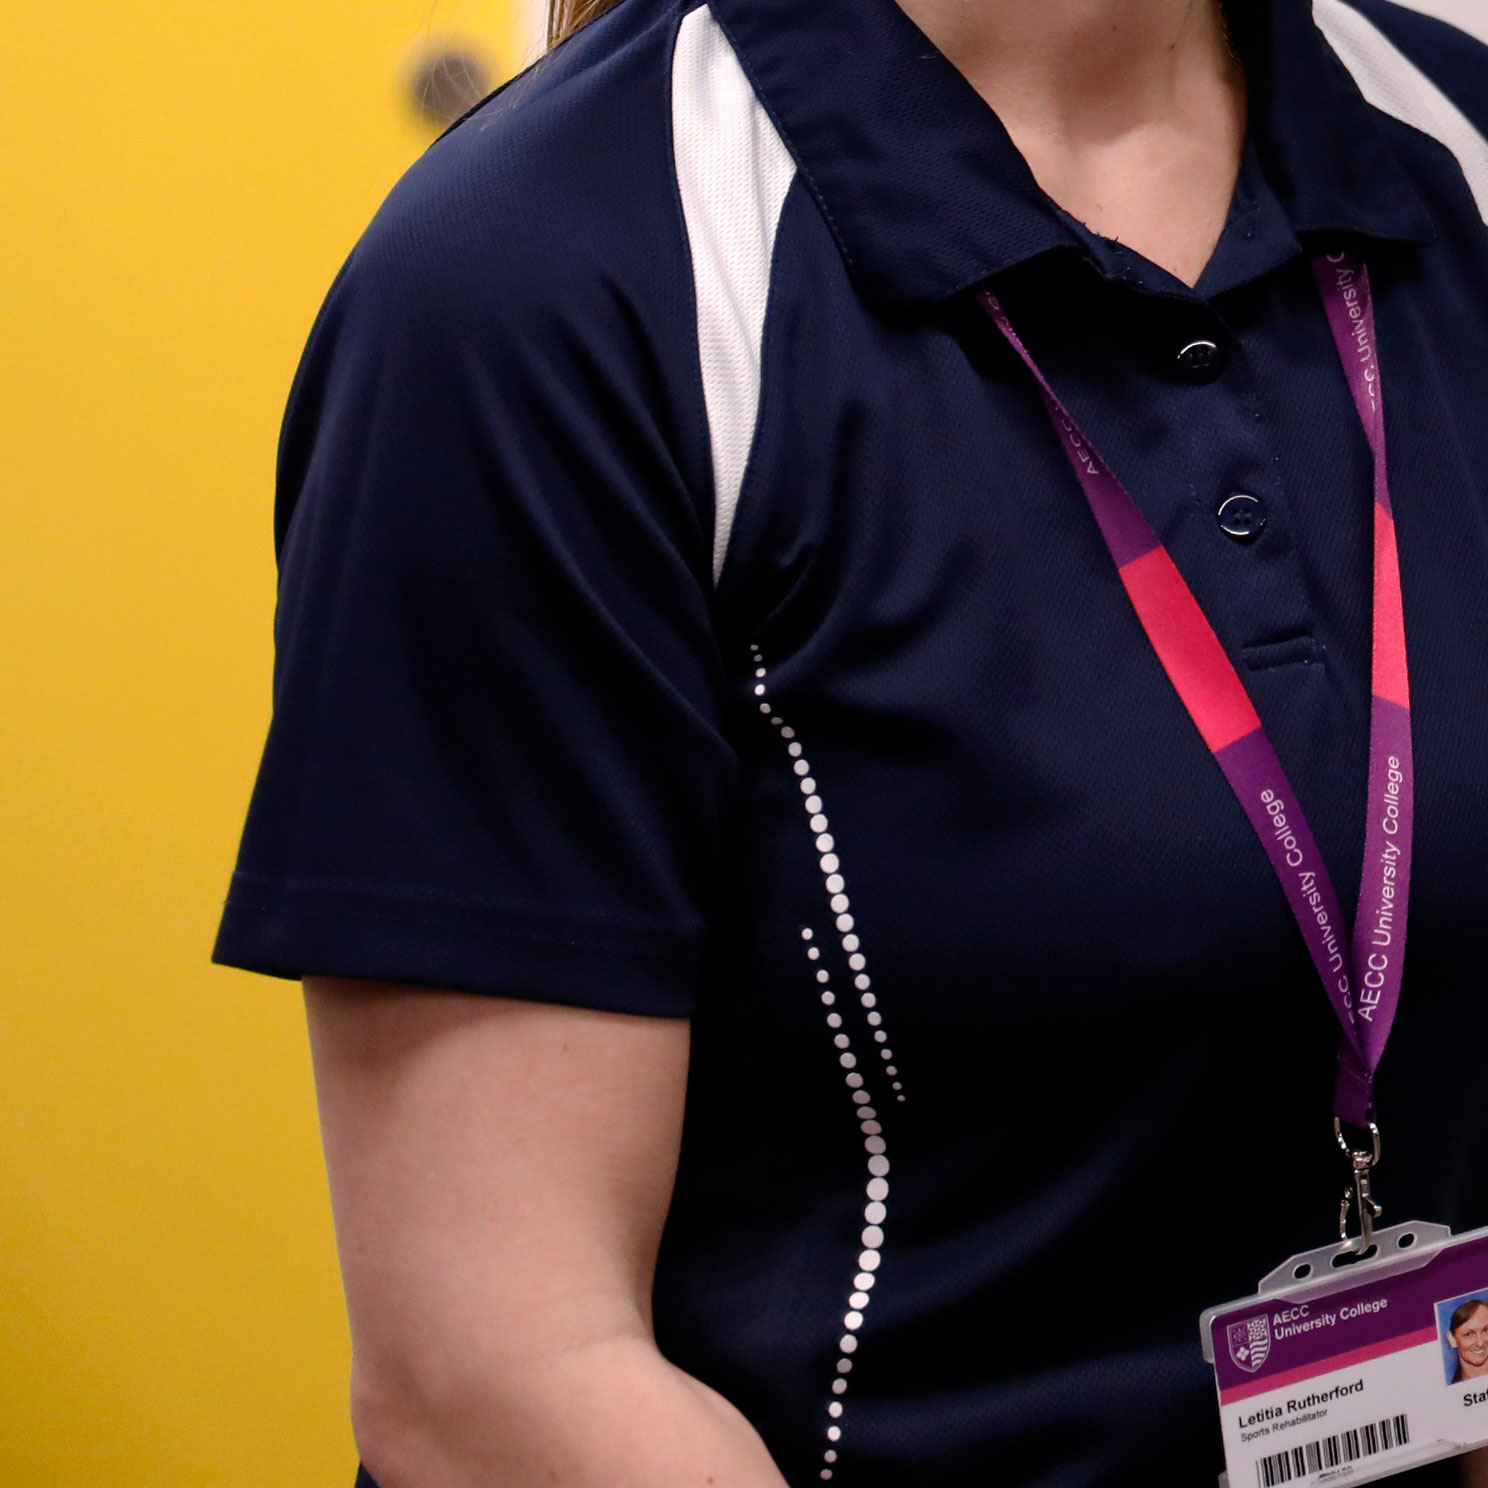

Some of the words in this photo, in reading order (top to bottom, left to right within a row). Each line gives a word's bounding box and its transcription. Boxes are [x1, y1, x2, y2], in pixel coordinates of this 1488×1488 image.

[1336, 268, 1372, 362] University
[1260, 788, 1304, 867] College
[1382, 755, 1403, 835] College
[1299, 871, 1343, 972] University
[1371, 840, 1401, 946] University
[1357, 953, 1388, 1022] AECC
[1273, 1304, 1310, 1326] AECC
[1274, 1313, 1337, 1340] University
[1340, 1298, 1388, 1321] College
[1238, 1406, 1283, 1429] Letitia
[1286, 1378, 1364, 1414] Rutherford
[1241, 1426, 1271, 1443] Sports
[1272, 1409, 1328, 1433] Rehabilitator
